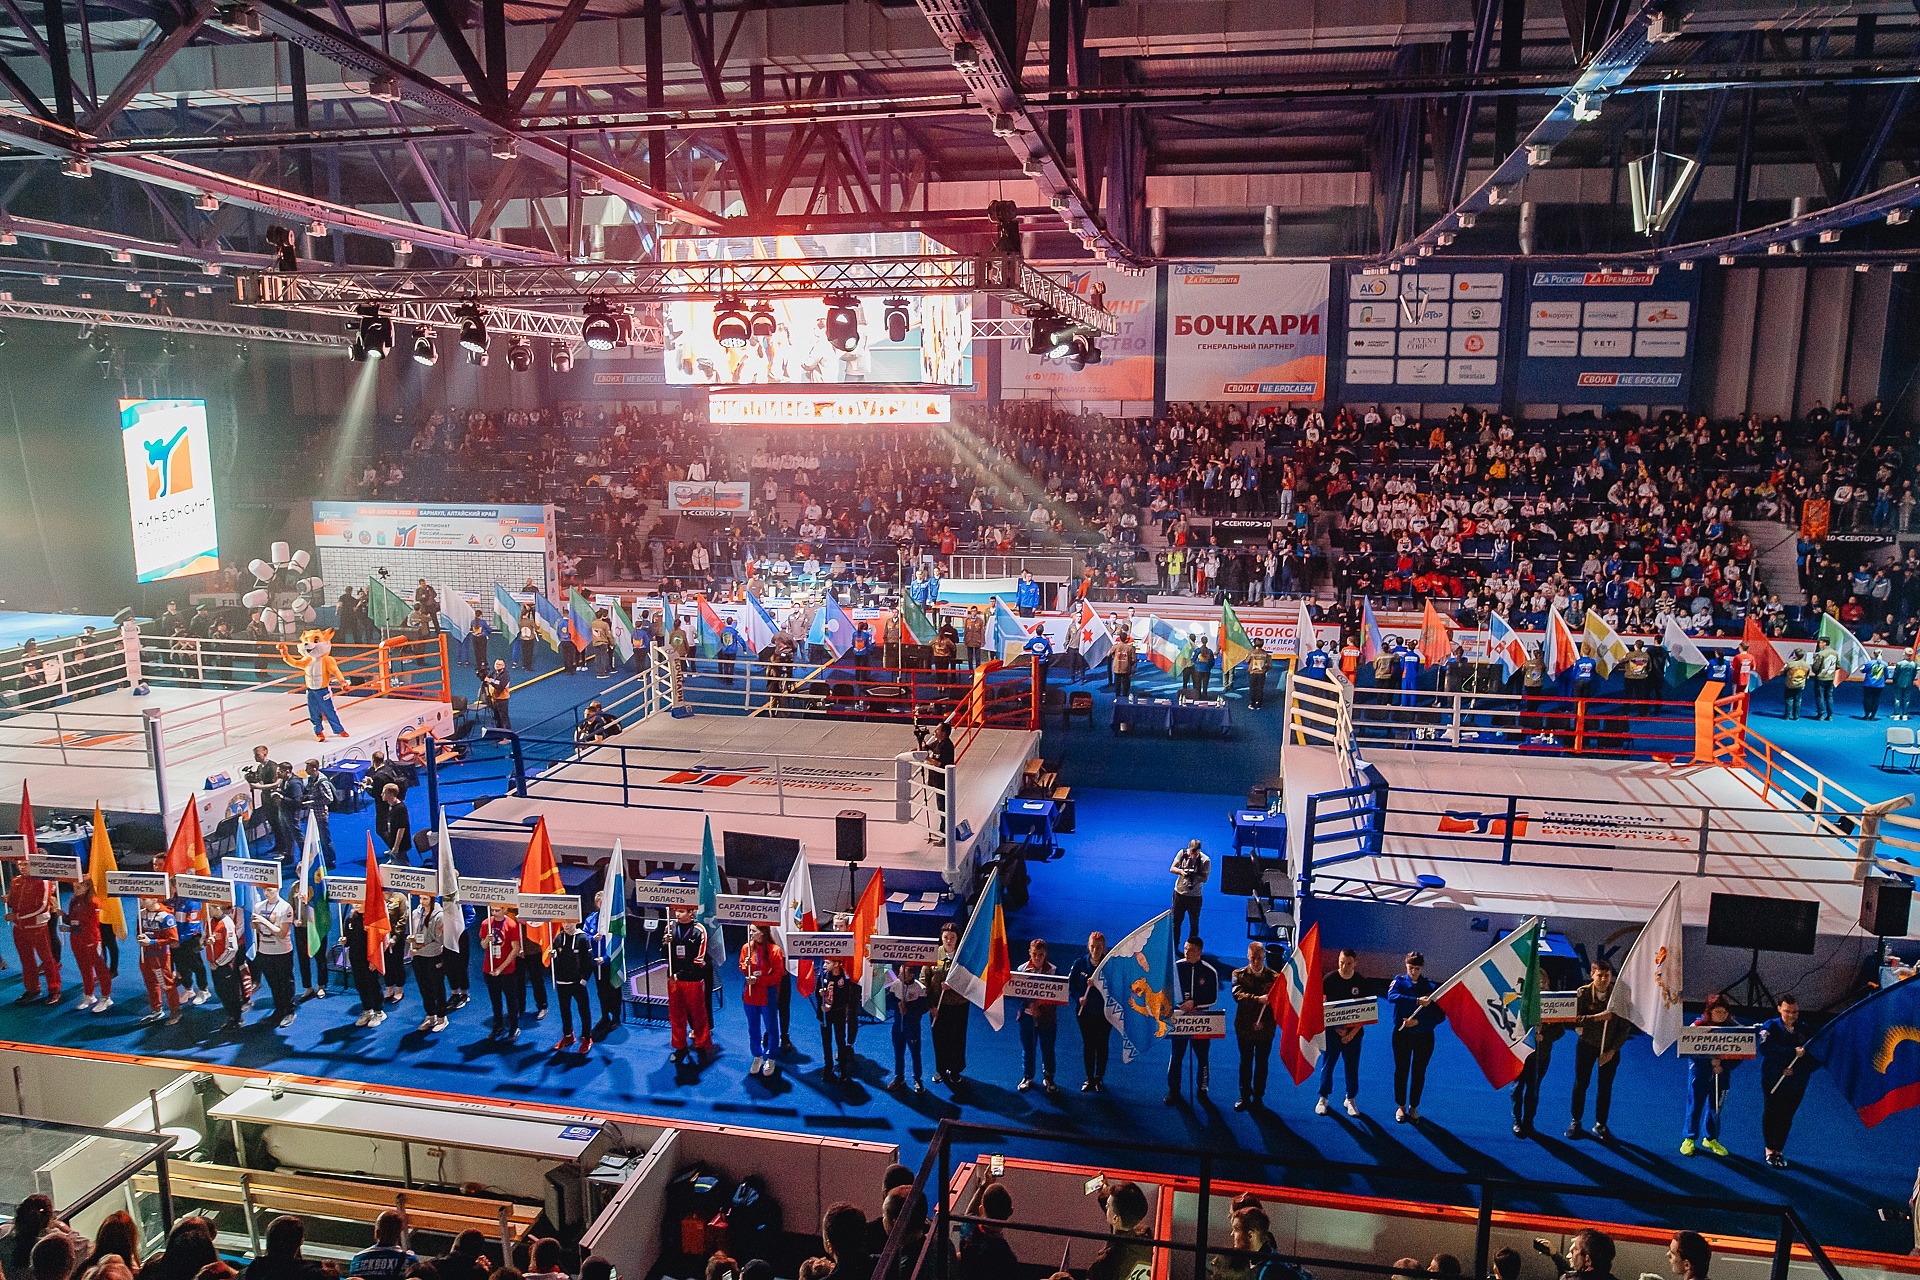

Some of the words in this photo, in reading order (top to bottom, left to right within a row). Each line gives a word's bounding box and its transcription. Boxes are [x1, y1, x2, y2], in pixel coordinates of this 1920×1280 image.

[1175, 315, 1320, 335] БОЧКАРИ
[1634, 376, 1676, 384] БРОСАЕМ
[674, 658, 683, 703] БОЧКАРИ
[782, 766, 885, 777] ЧЕМПИОНАТ
[1544, 811, 1666, 823] ЧЕМПИОНАТ
[1563, 826, 1664, 835] КИКБОКСИНГУ
[1541, 829, 1638, 839] БАРНАУЛ
[1643, 834, 1691, 842] 2022
[31, 862, 77, 870] ЯРОСЛАВСКАЯ
[227, 864, 274, 875] ТЮМЕНСКАЯ
[234, 872, 268, 882] ОБЛАСТЬ
[390, 873, 425, 882] ТОМСКАЯ
[108, 878, 164, 886] ЧЕЛЯБИНСКАЯ
[391, 880, 425, 890] ОБЛАСТЬ
[119, 885, 154, 893] ОБЛАСТЬ
[178, 882, 231, 892] УЛЬЯНОВСКАЯ
[460, 885, 514, 895] СМОЛЕНСКАЯ
[638, 886, 695, 895] САХАЛИНСКАЯ
[189, 890, 221, 899] ОБЛАСТЬ
[469, 893, 506, 901] ОБЛАСТЬ
[649, 895, 685, 904] ОБЛАСТЬ
[520, 902, 578, 911] СВЕРДЛОВСКАЯ
[718, 903, 778, 913] САРАТОВСКАЯ
[532, 909, 566, 917] ОБЛАСТЬ
[729, 911, 768, 920] ОБЛАСТЬ
[873, 944, 935, 953] РОСТОВСКАЯ
[883, 951, 925, 959] ОБЛАСТЬ
[1008, 979, 1063, 991] ПСКОВСКАЯ
[1015, 988, 1056, 999] ОБЛАСТЬ
[1325, 1005, 1376, 1018] ОСИБИРСКАЯ
[1326, 1014, 1361, 1023] ОБЛАСТЬ
[1682, 1035, 1754, 1044] МУРМАНСКАЯ
[1694, 1044, 1742, 1053] ОБЛАСТЬ
